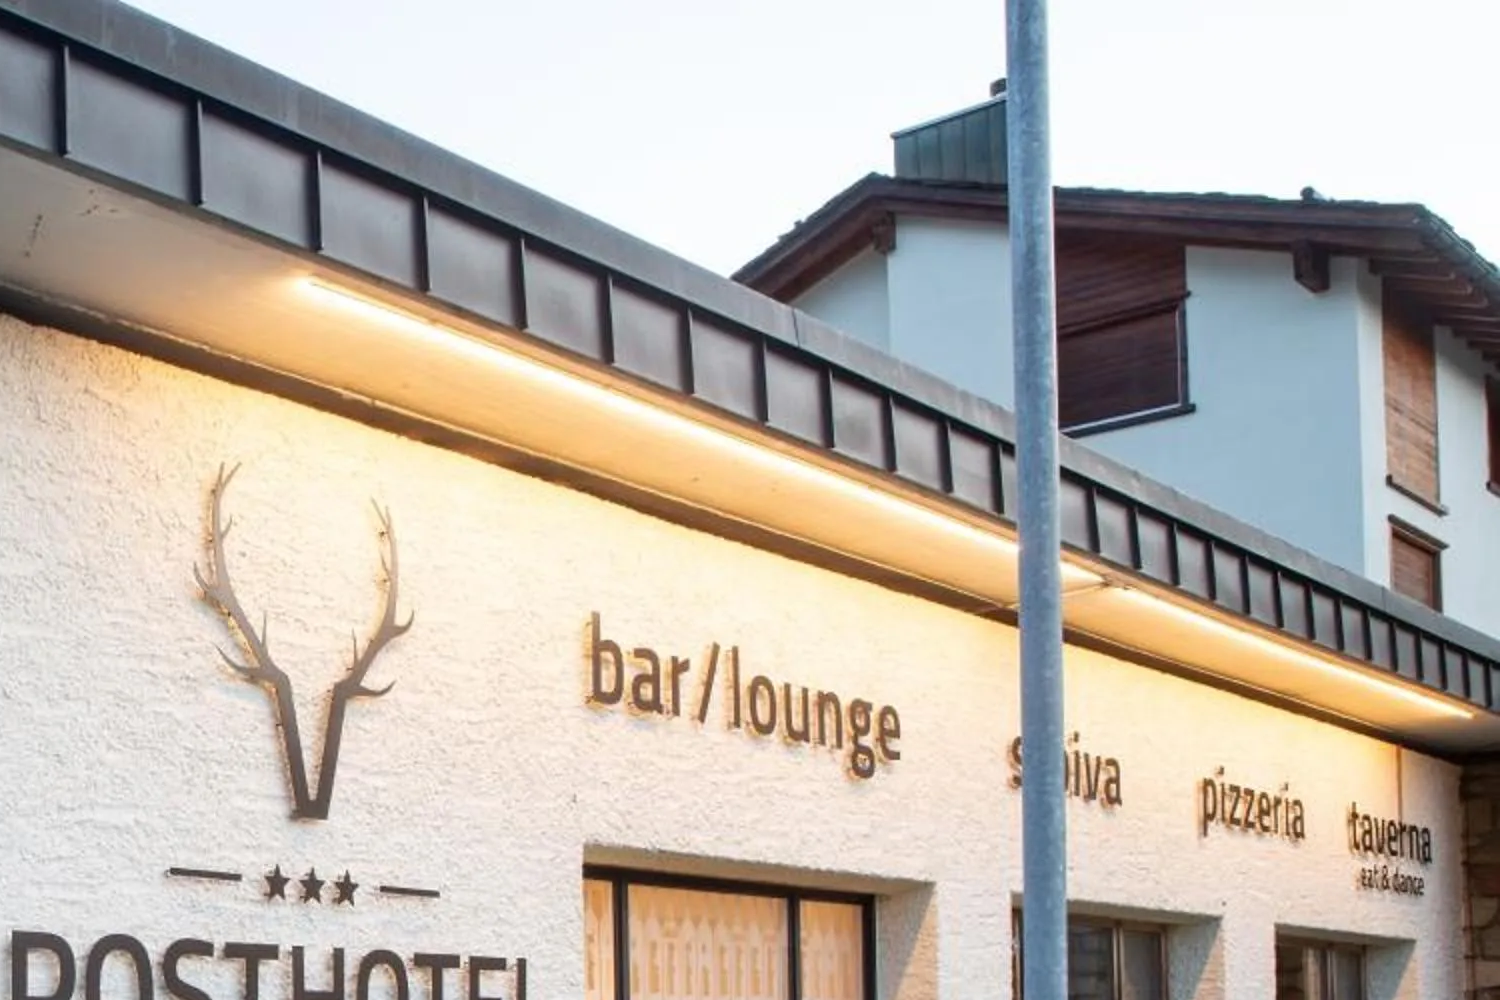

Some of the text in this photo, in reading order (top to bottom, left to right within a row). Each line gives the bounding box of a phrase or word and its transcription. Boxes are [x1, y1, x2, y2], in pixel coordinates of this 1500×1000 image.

[590, 610, 901, 779] bar/lounge
[1202, 765, 1306, 841] pizzeria
[1349, 802, 1433, 864] taverna
[1360, 865, 1425, 896] eat & dance
